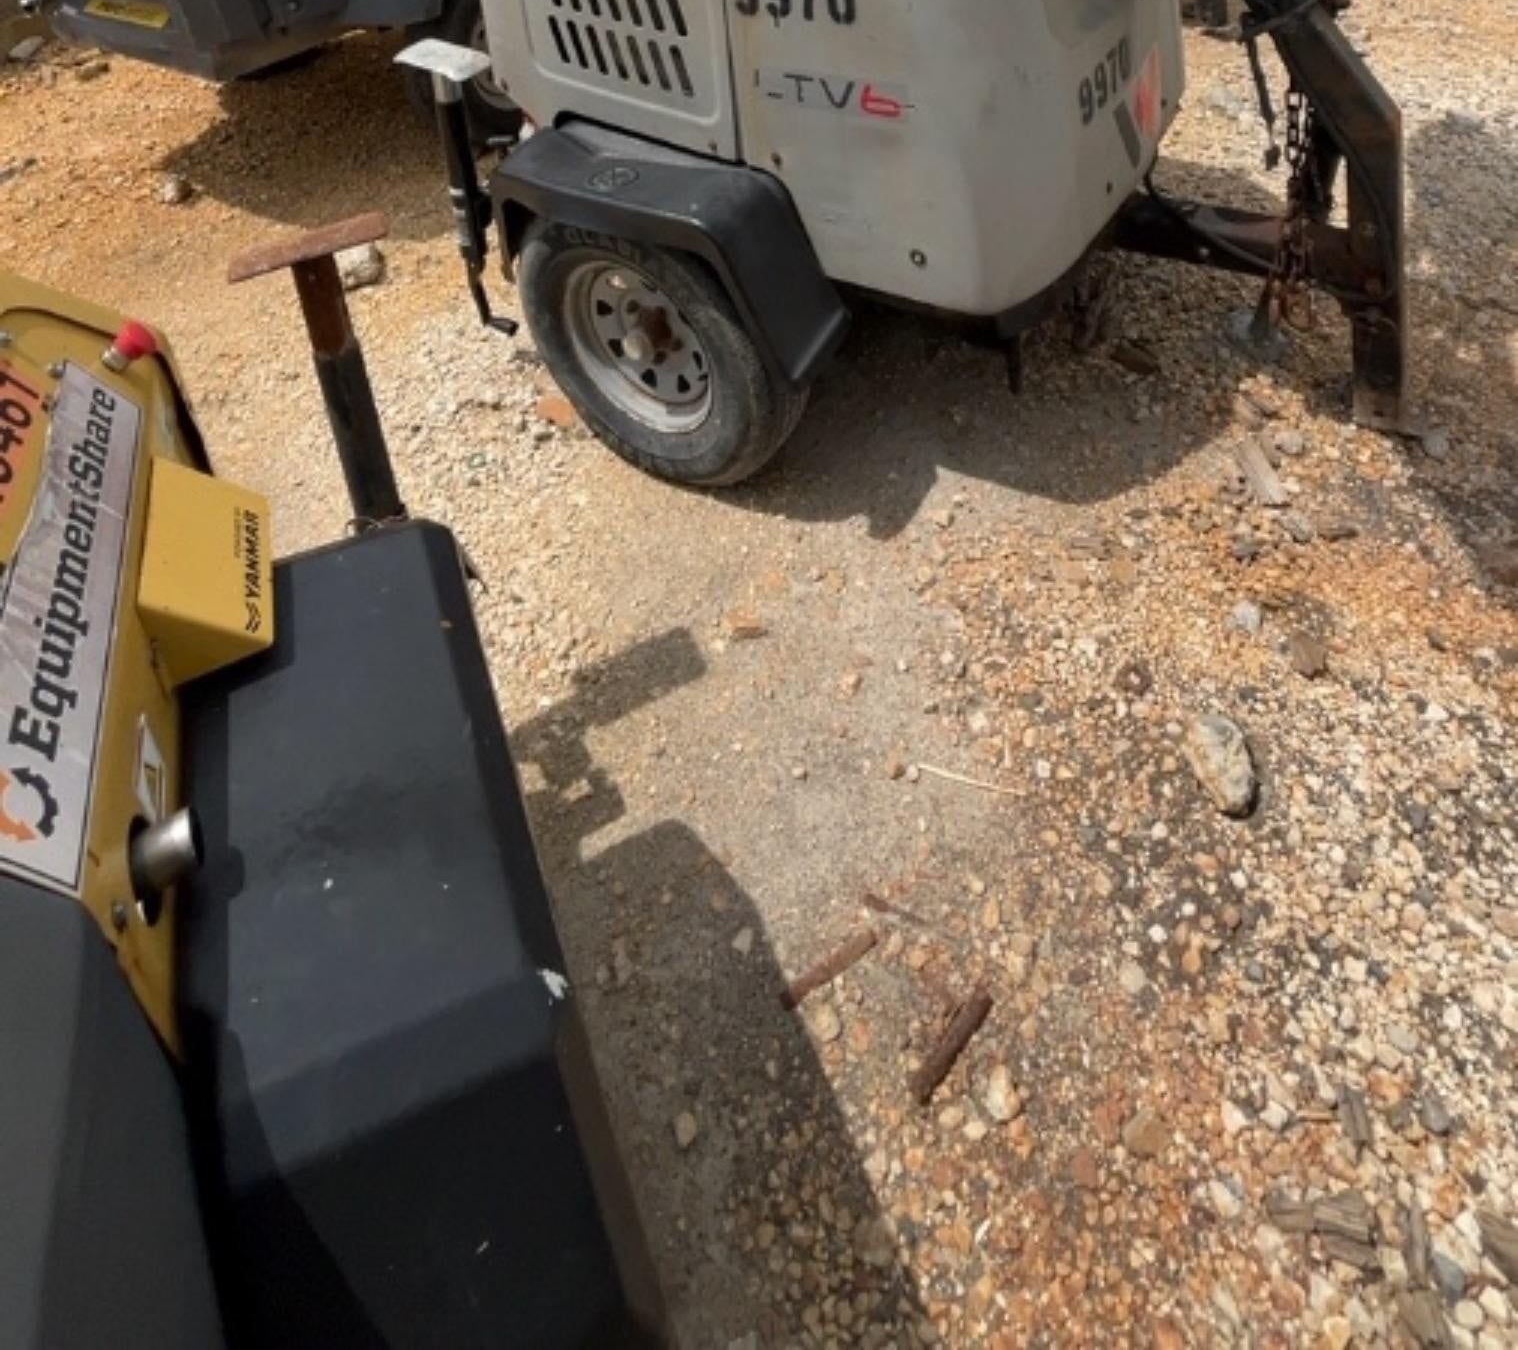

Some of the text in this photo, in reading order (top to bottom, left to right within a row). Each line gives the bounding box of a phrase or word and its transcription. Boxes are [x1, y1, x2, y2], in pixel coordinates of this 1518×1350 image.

[1078, 35, 1132, 126] 9970
[7, 387, 117, 763] EquipmentShare
[244, 509, 261, 598] YANMAR
